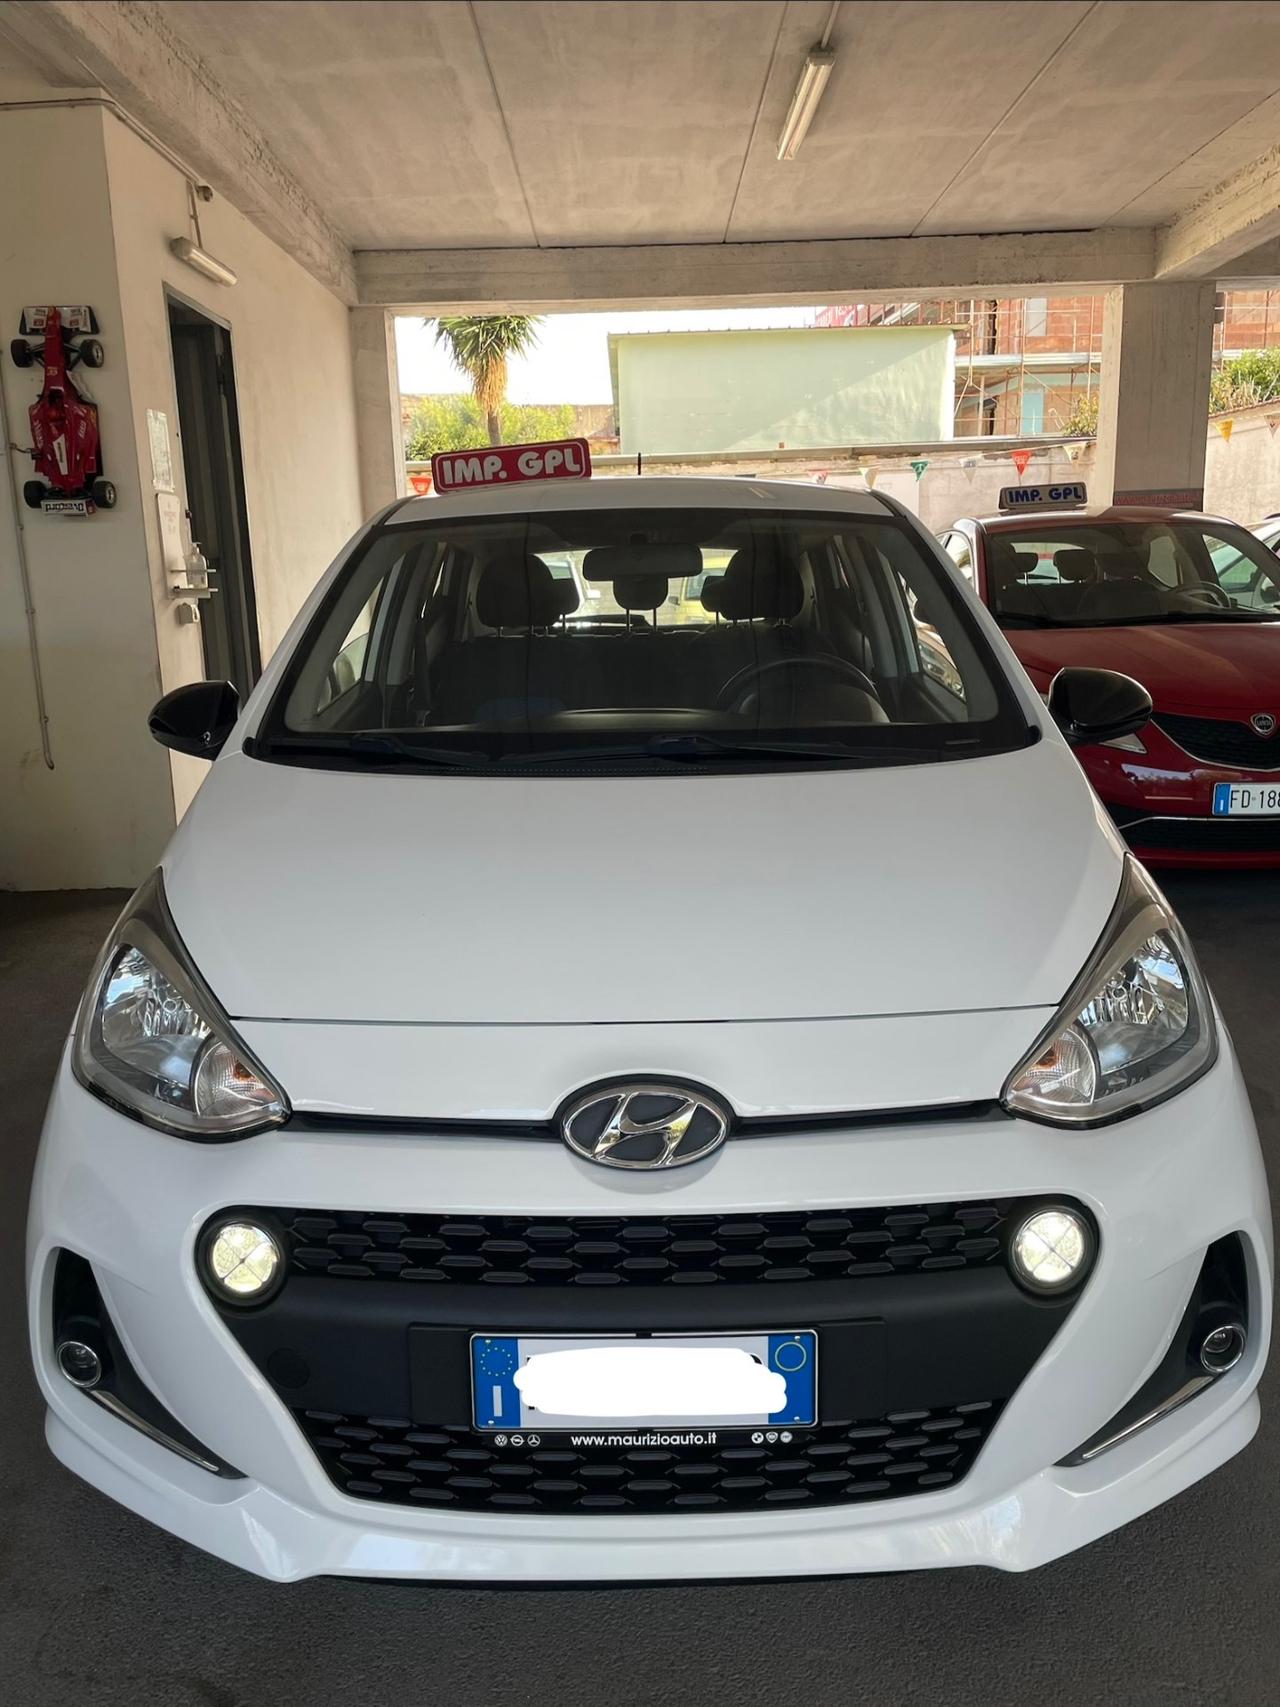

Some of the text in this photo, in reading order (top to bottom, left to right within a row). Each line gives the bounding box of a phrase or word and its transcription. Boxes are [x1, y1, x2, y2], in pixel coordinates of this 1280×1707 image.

[442, 447, 581, 485] IMP. GPL
[1008, 486, 1082, 503] IMP. GPL
[570, 1432, 717, 1447] www.maurizioauto.it
